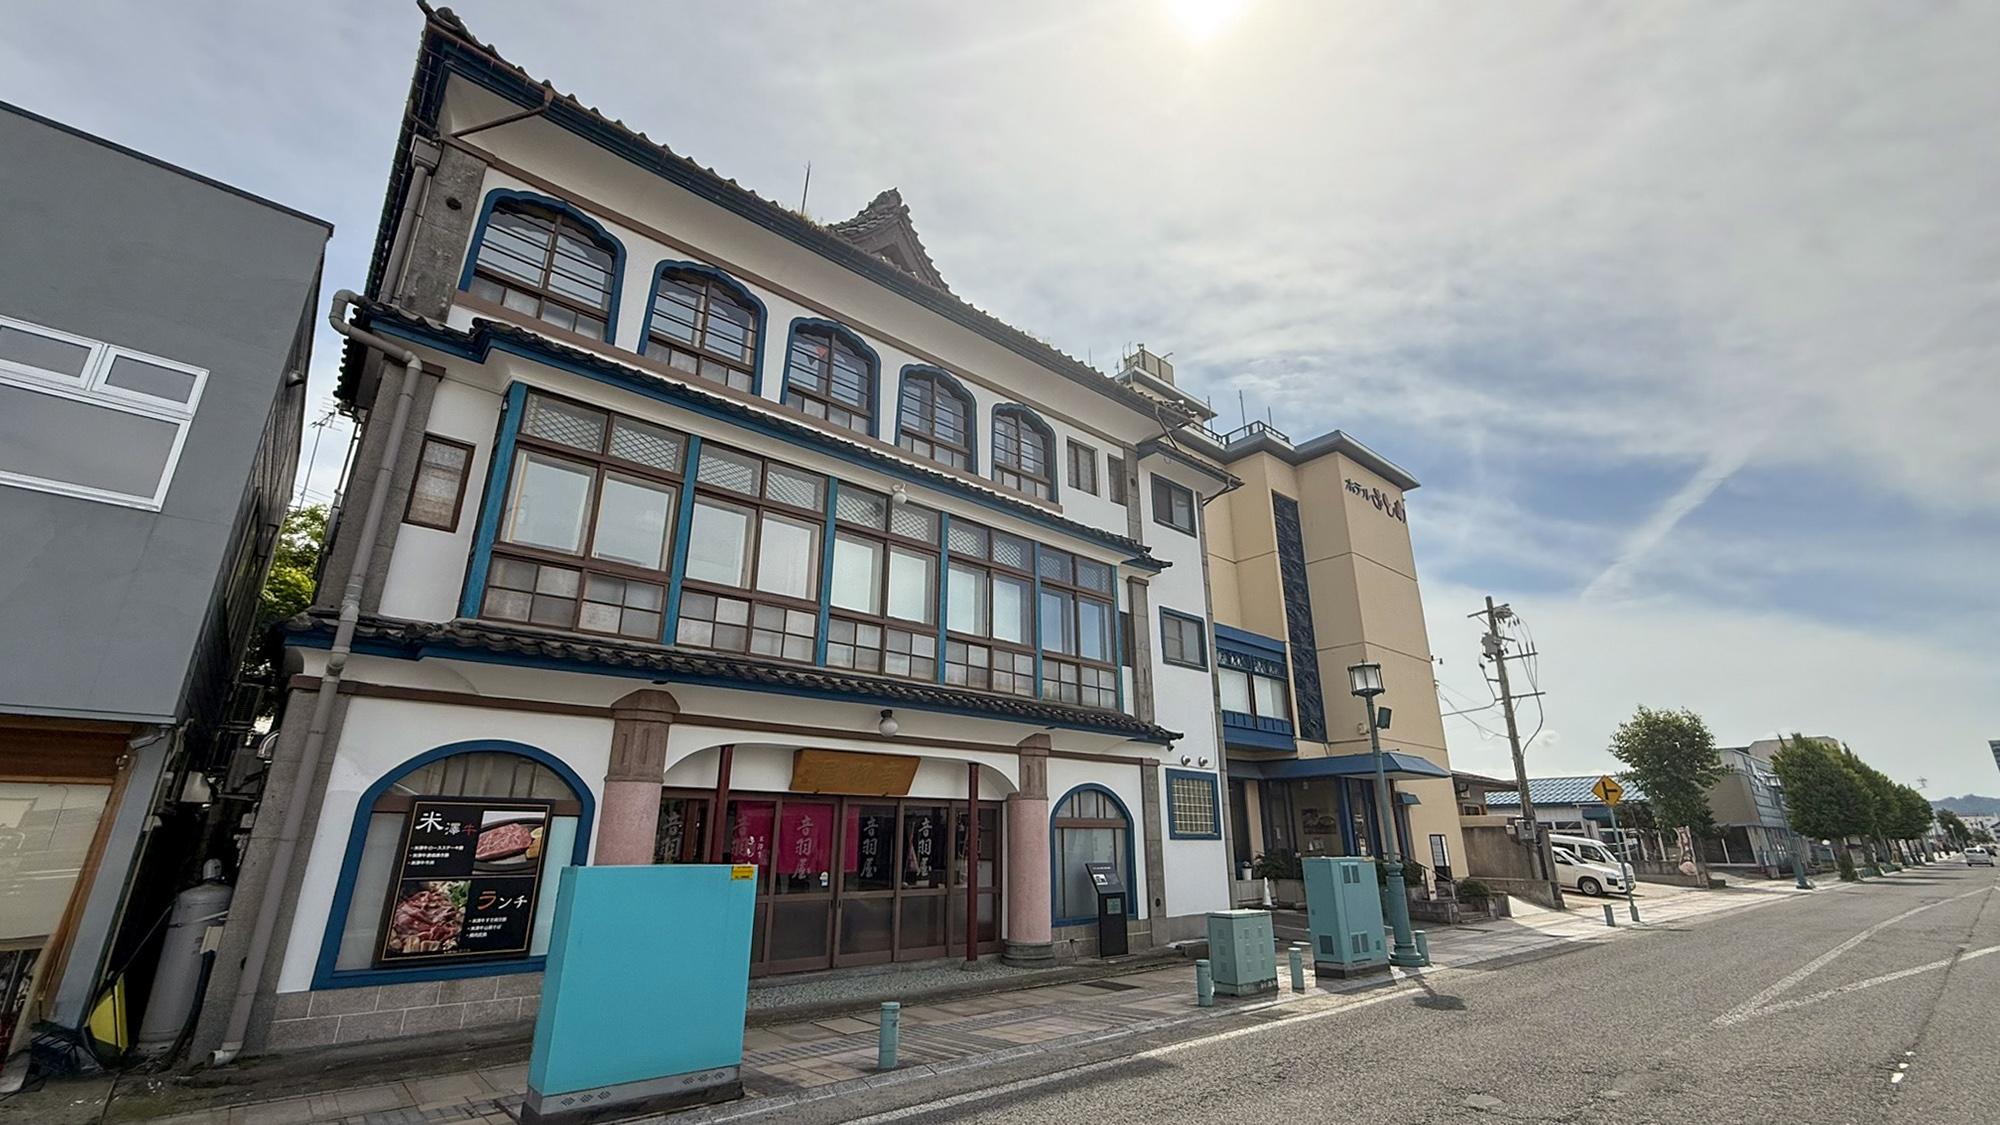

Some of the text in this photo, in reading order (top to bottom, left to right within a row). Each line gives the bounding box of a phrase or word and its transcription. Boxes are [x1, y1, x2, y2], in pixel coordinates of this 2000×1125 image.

[415, 810, 478, 836] 米澤牛
[791, 815, 815, 880] 音羽屋
[860, 816, 879, 878] 音羽屋
[917, 817, 933, 877] 音羽屋
[477, 890, 528, 911] ランチ
